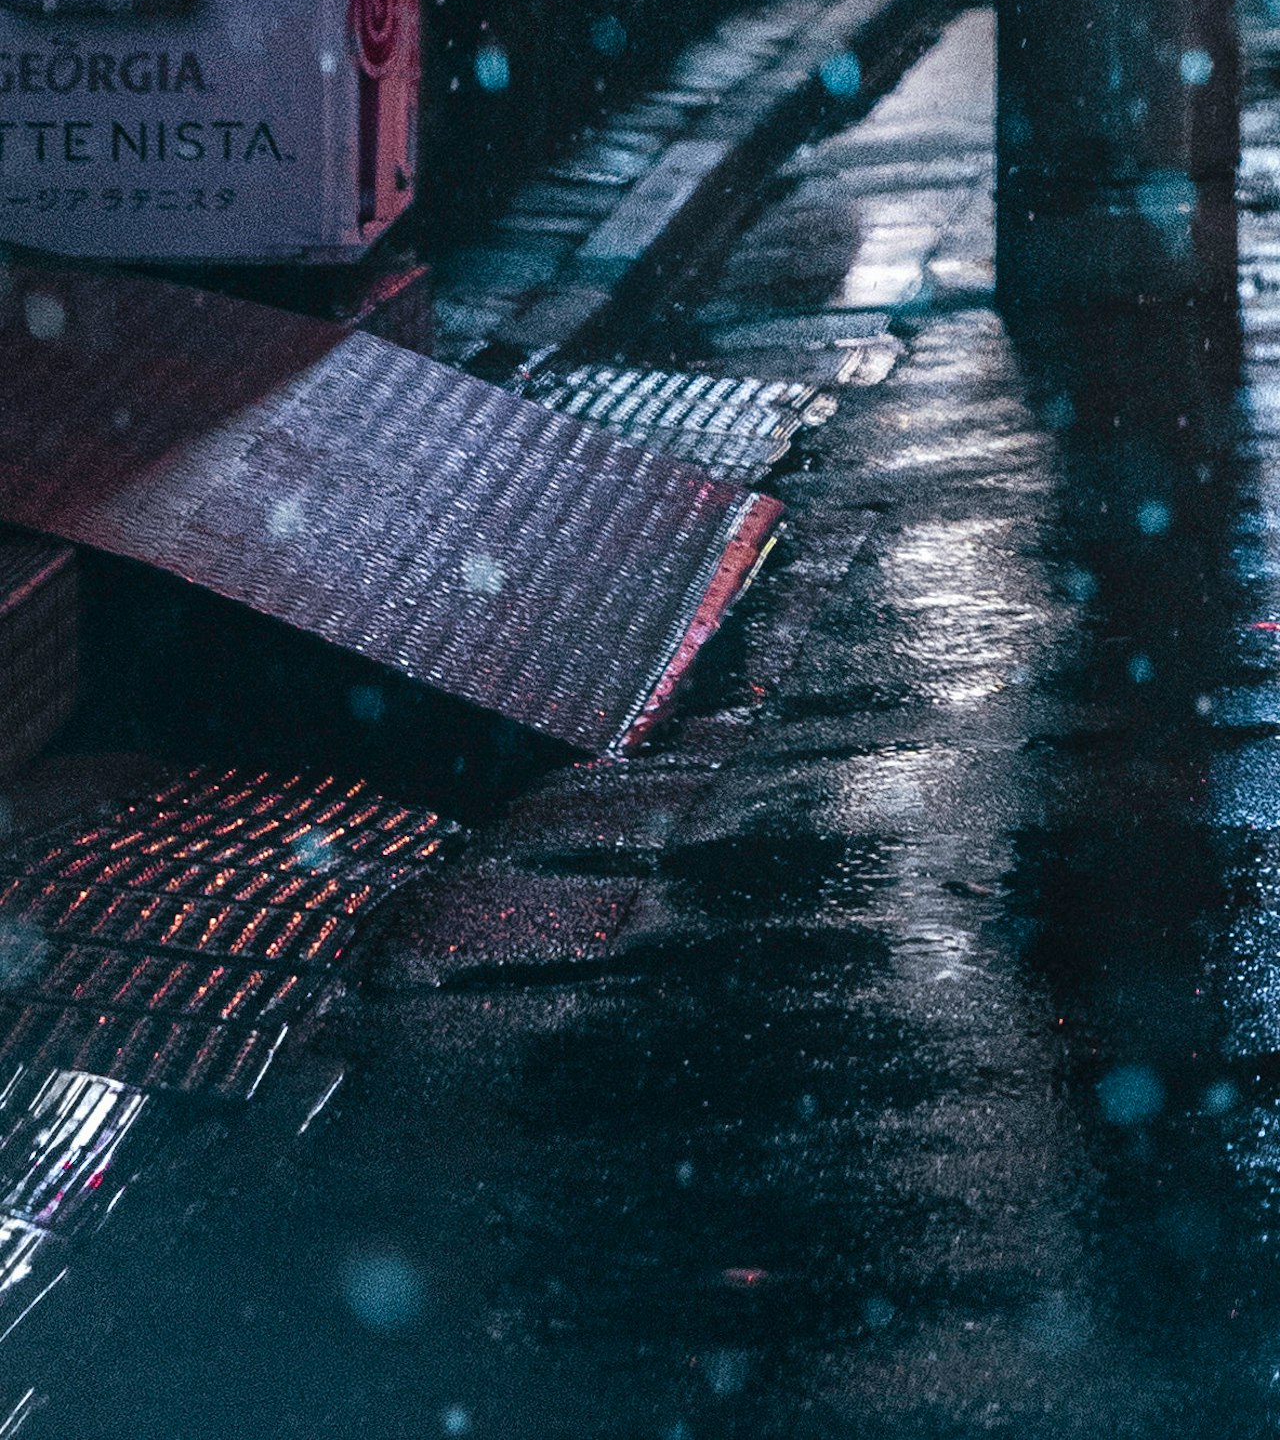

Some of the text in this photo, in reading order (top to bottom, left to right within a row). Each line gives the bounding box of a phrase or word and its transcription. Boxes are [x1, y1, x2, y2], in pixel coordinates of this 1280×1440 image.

[111, 121, 284, 164] NISTA
[101, 187, 237, 211] ラテニスタ
